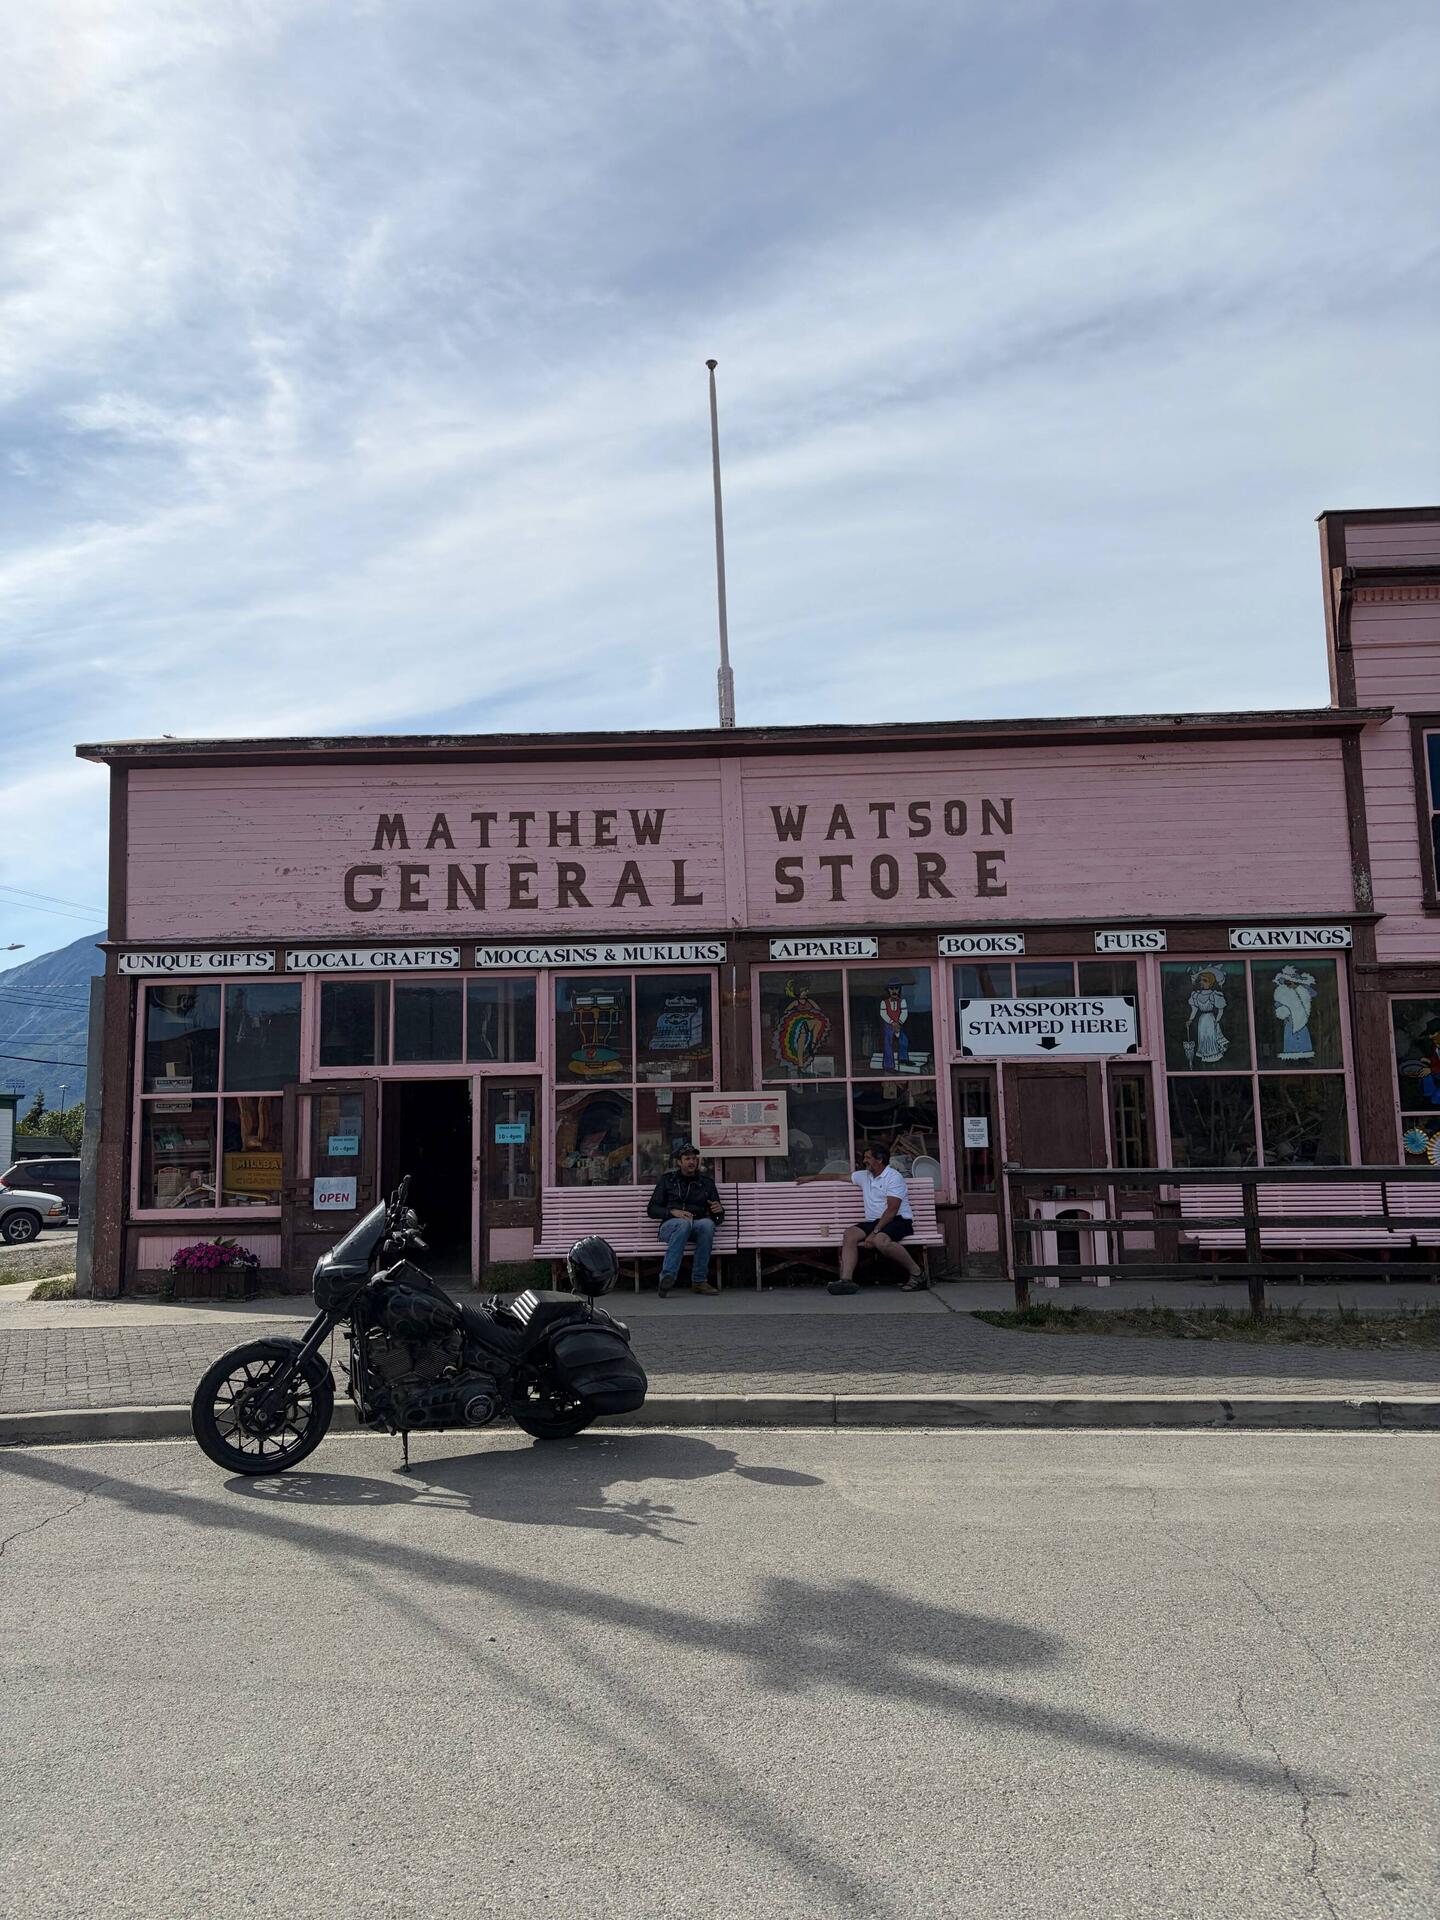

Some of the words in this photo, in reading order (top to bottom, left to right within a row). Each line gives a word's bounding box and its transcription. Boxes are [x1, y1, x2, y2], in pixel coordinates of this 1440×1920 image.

[371, 808, 666, 850] MATTHEW
[769, 797, 1014, 842] WATSON
[344, 858, 703, 912] GENERAL
[775, 850, 1007, 904] STORE
[946, 937, 1017, 952] BOOKS
[1103, 933, 1159, 948] FURS
[1237, 929, 1345, 946] CARVINGS
[484, 948, 598, 964] MOCCASINS
[604, 948, 616, 961] &
[623, 945, 719, 961] MUKLUKS
[778, 941, 870, 957] APPAREL
[126, 954, 202, 971] UNIQUE
[208, 953, 267, 967] GIFTS
[294, 953, 364, 968] LOCAL
[370, 951, 453, 966] CRAFTS
[990, 1002, 1104, 1017] PASSPORTS
[969, 1020, 1064, 1035] STAMPED
[1071, 1019, 1128, 1034] HERE
[319, 1193, 350, 1203] OPEN
